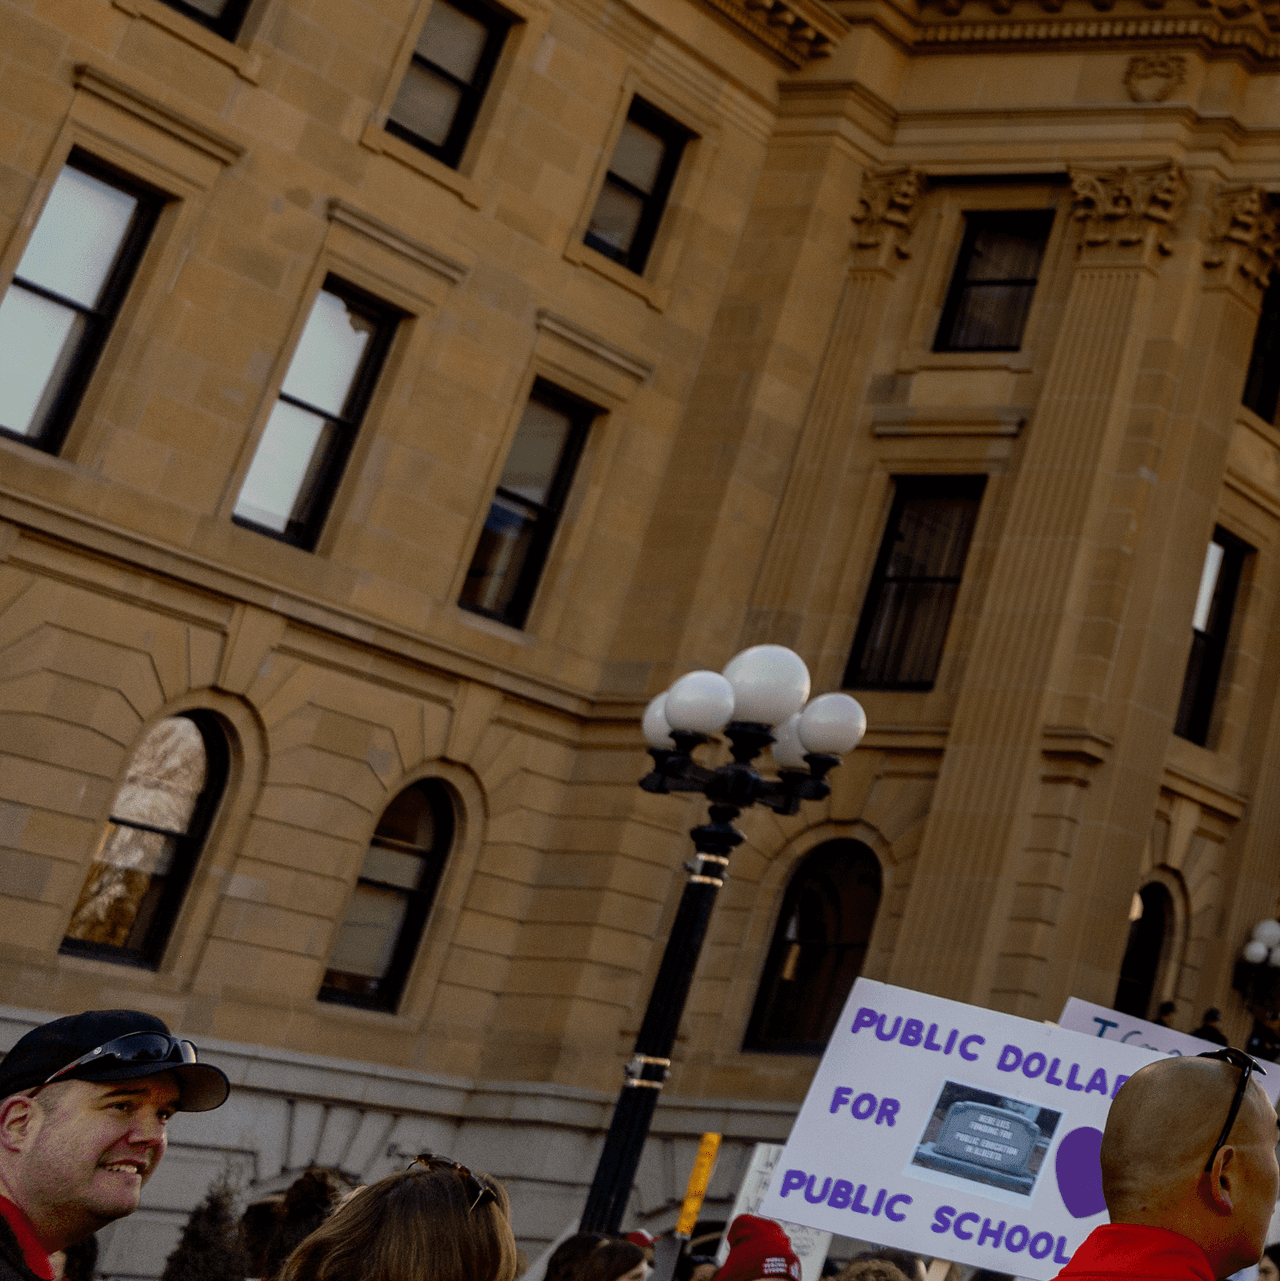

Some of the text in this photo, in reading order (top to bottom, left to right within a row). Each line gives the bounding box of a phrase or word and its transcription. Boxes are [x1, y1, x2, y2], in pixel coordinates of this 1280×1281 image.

[851, 1007, 986, 1062] PUBLIC
[829, 1086, 901, 1127] FOR
[953, 1131, 1020, 1157] PUBLIC EDUCATION
[779, 1169, 914, 1222] PUBLIC
